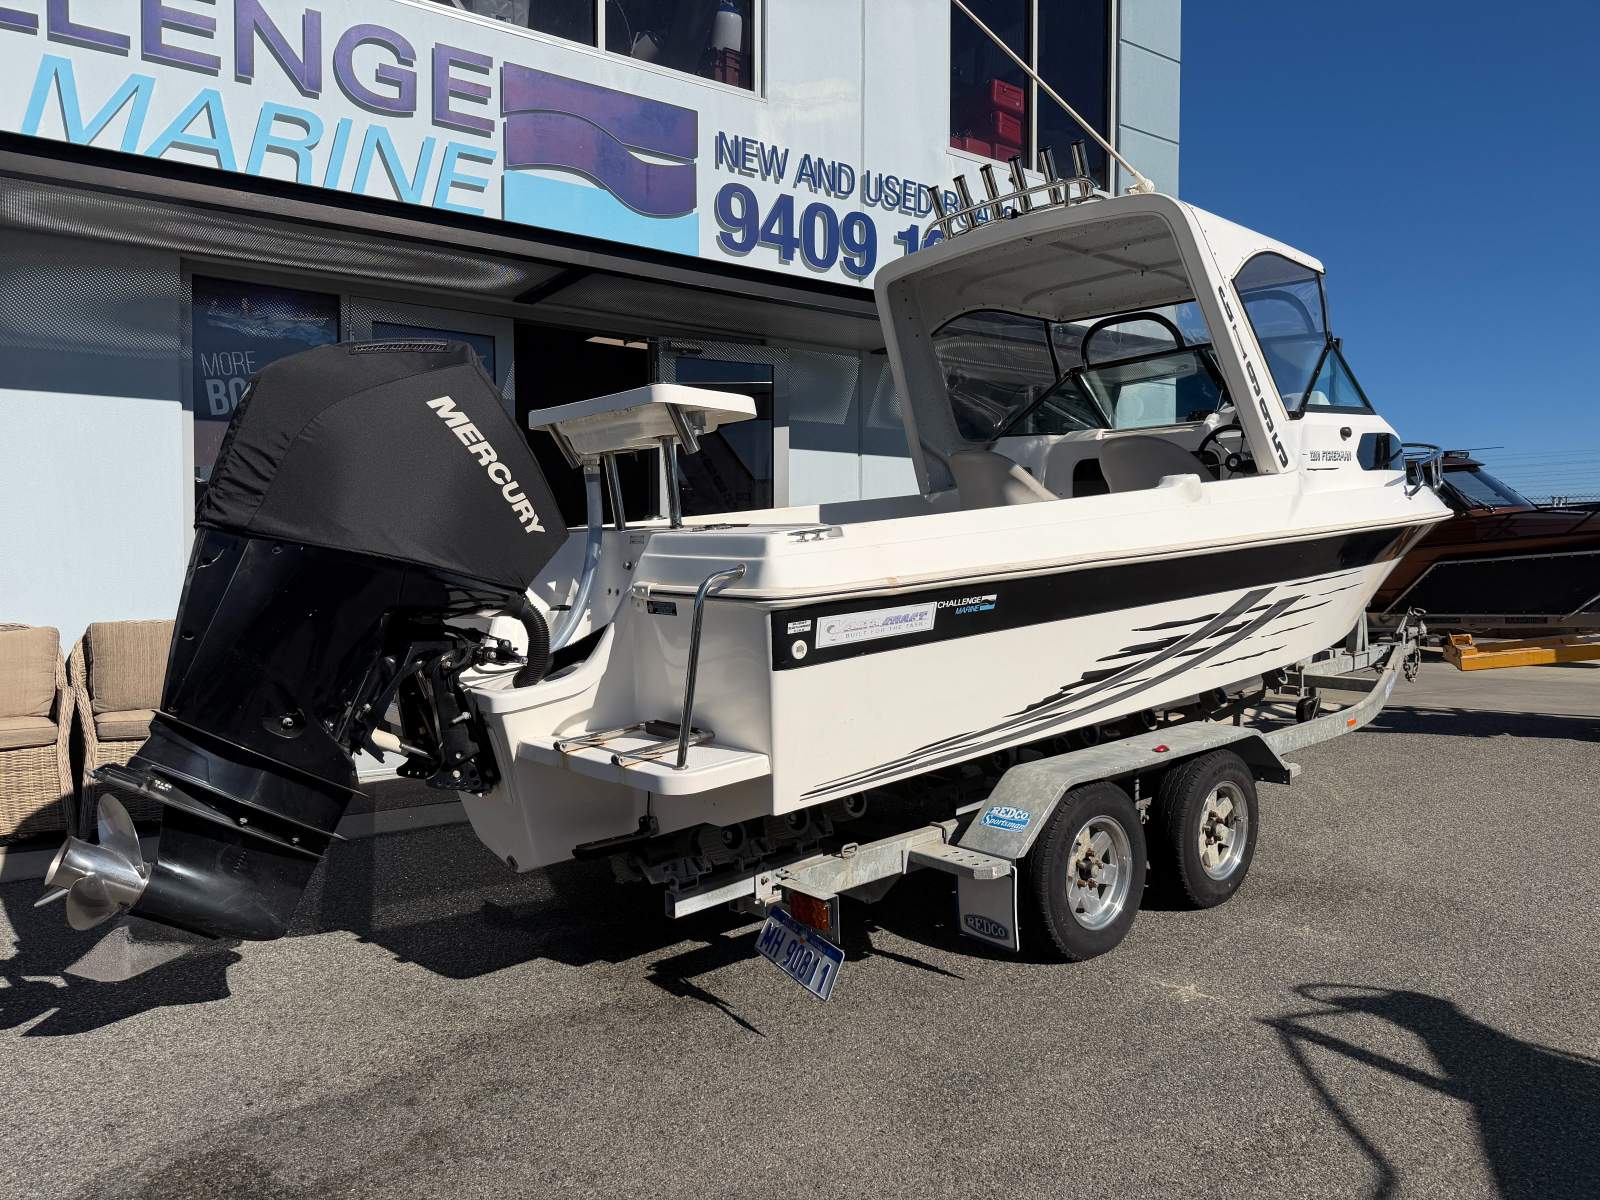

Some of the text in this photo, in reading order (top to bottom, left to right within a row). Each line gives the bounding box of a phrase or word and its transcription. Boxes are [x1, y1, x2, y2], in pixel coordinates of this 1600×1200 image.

[0, 0, 496, 135] LENGE
[20, 53, 497, 216] MARINE
[716, 131, 789, 182] NEW
[795, 154, 855, 198] AND
[863, 169, 932, 217] USED
[716, 182, 878, 278] 9409
[200, 350, 257, 377] MORE
[426, 395, 546, 535] MERCURY
[937, 596, 982, 609] CHALLENGE
[955, 604, 981, 615] MARINE
[983, 814, 1026, 831] Sportsman
[760, 922, 786, 958] MH
